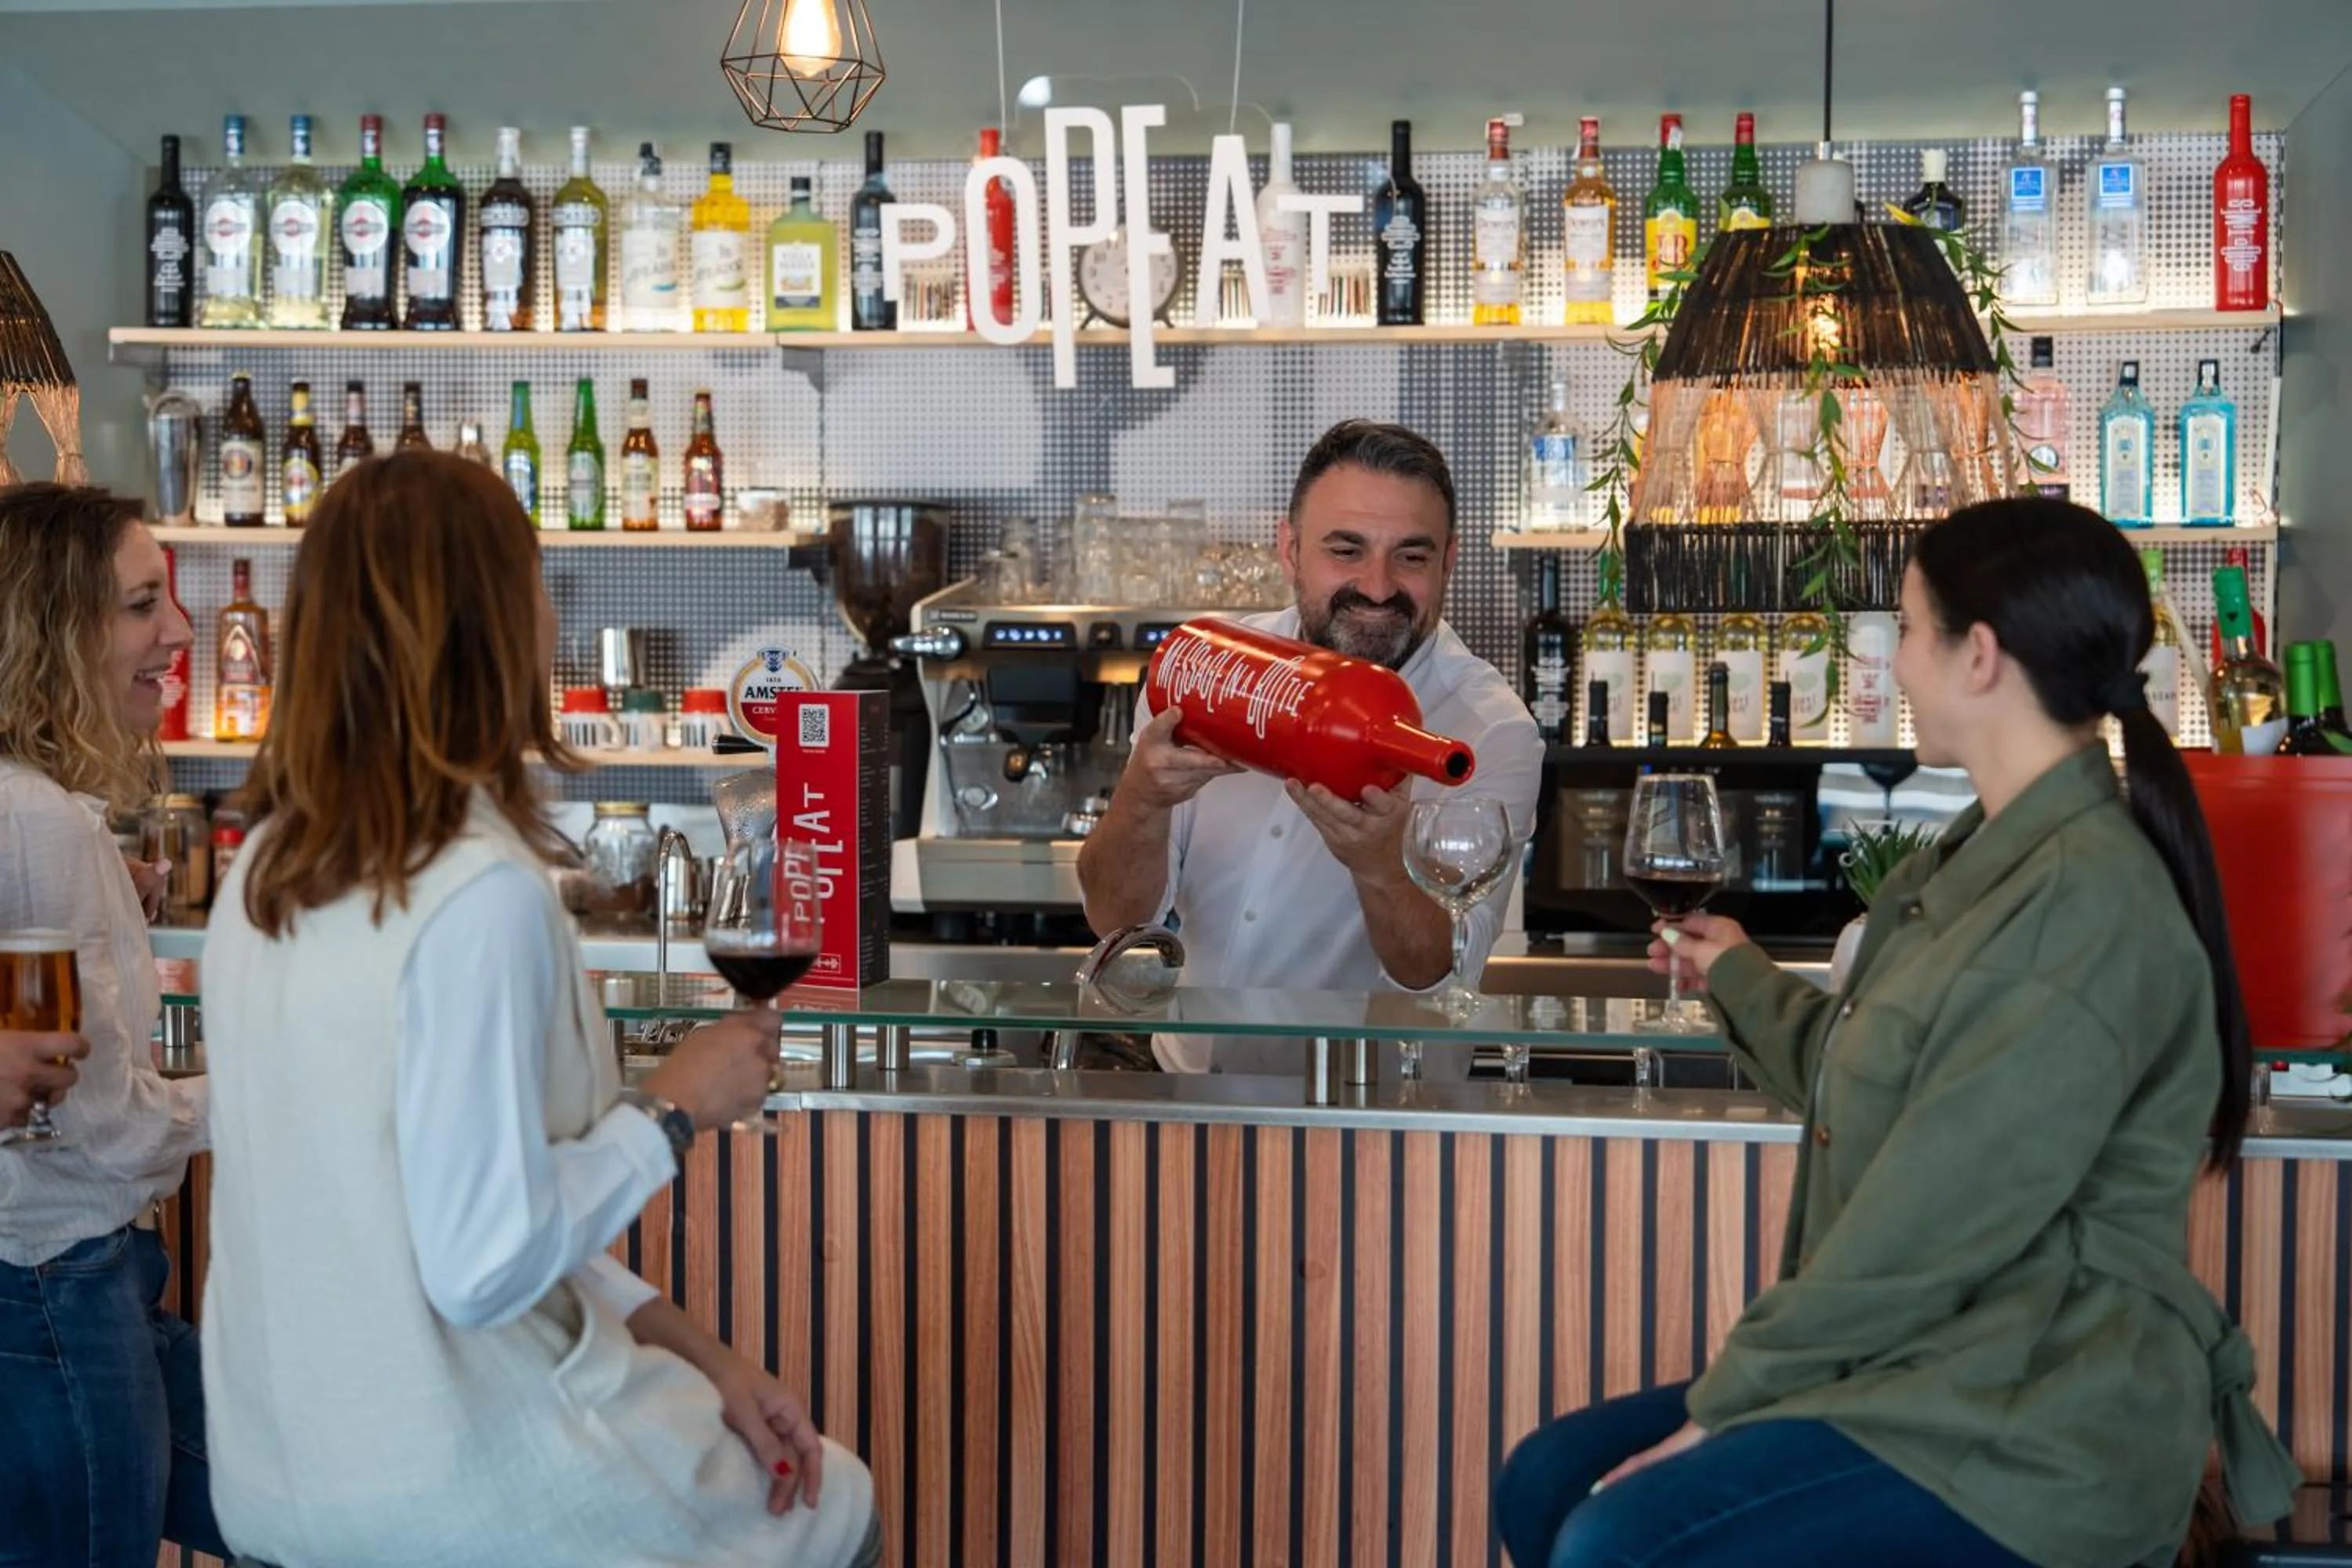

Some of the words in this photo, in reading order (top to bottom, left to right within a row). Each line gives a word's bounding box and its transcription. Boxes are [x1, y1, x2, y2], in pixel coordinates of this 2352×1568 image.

[2220, 198, 2262, 237] TIMES
[880, 104, 1363, 389] POPEAT
[2220, 238, 2262, 272] GOOD
[1156, 633, 1236, 713] MESSAGE
[1218, 654, 1249, 705] IN
[1240, 670, 1255, 698] A
[1247, 655, 1315, 739] BOTTLE
